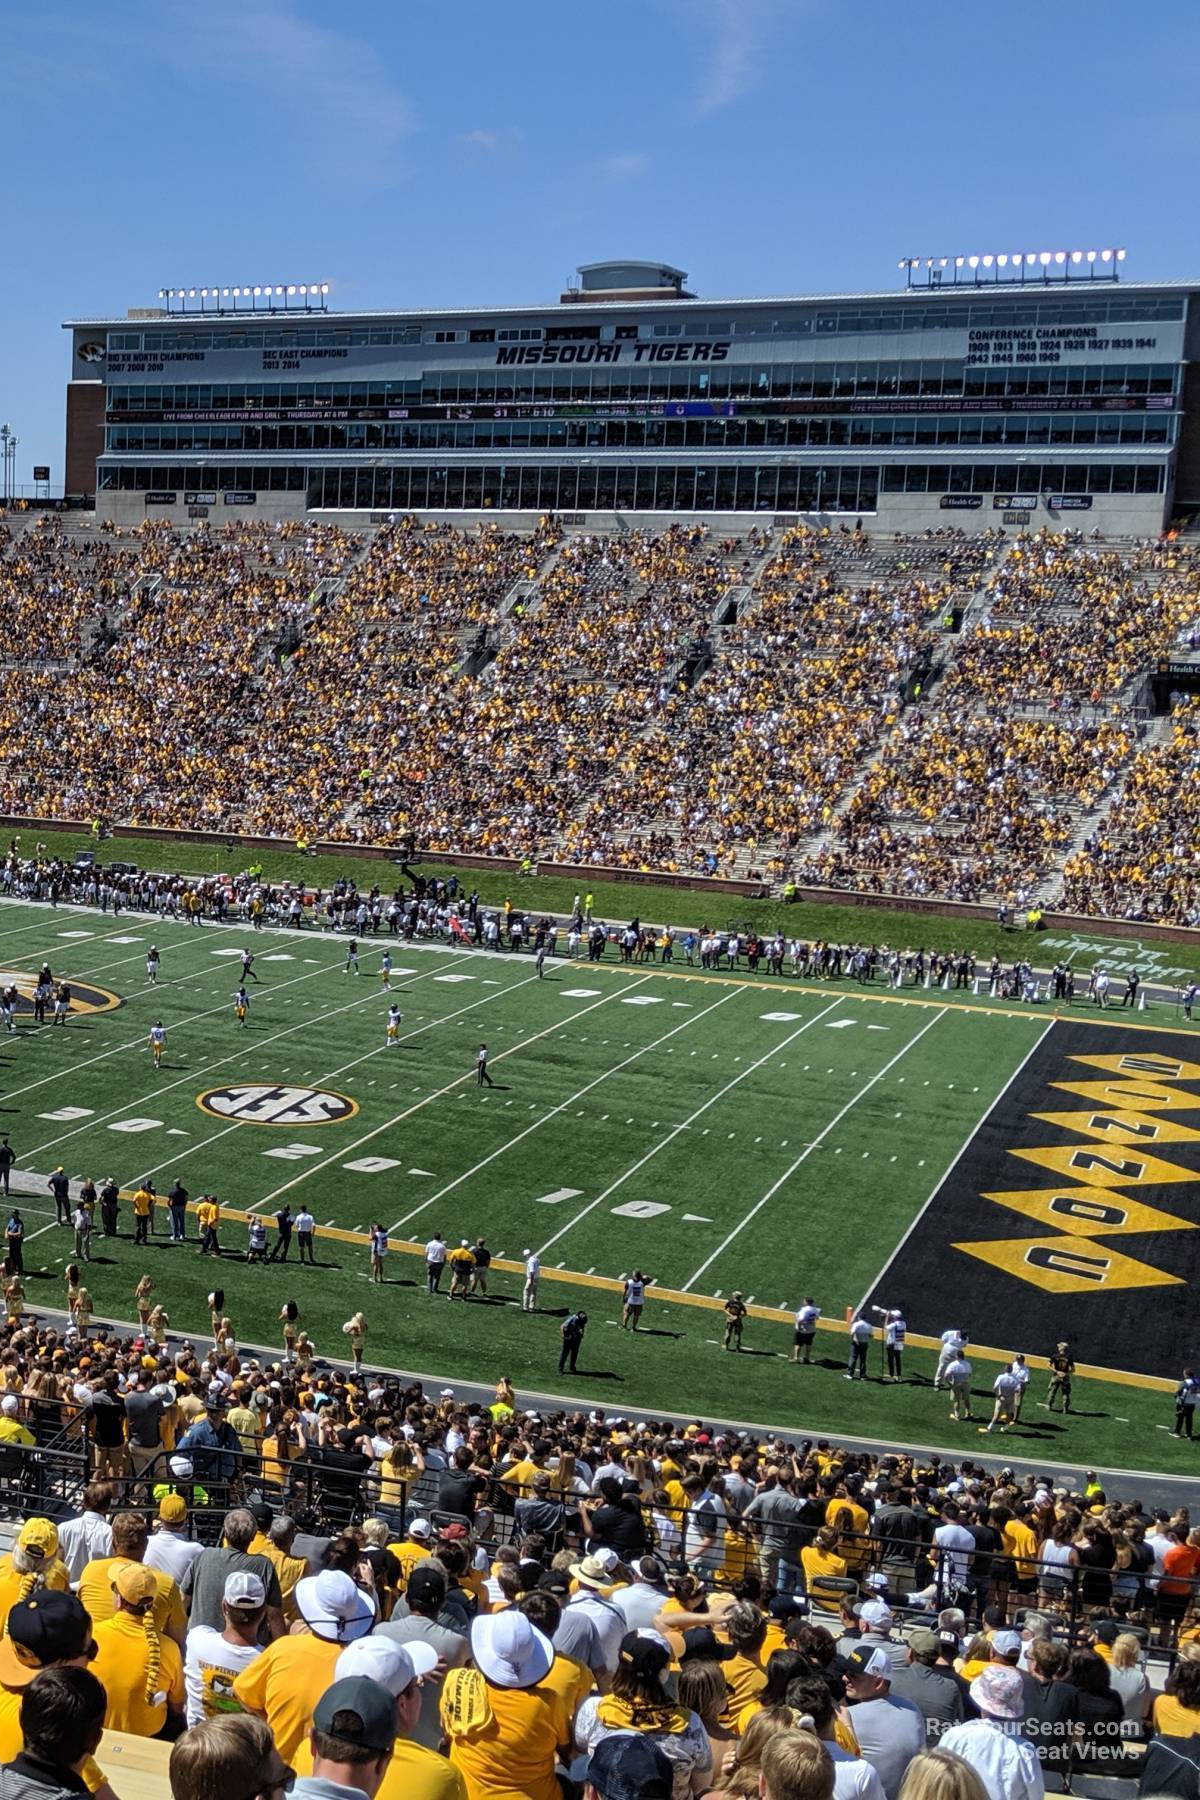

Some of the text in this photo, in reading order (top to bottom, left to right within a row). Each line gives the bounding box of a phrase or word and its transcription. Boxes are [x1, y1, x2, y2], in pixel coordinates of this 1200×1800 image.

[968, 327, 1098, 340] CONFERENCE CHAMPIONS
[968, 342, 991, 353] 1909
[1017, 341, 1038, 352] 1919
[1039, 340, 1062, 351] 1924
[1088, 339, 1111, 350] 1927
[1111, 338, 1134, 349] 1939
[1135, 338, 1158, 349] 1941
[133, 353, 158, 362] NORTH
[159, 352, 206, 361] CHAMPIONS
[262, 349, 349, 360] SEC EAST CHAMPIONS
[496, 342, 732, 365] MISSOURI TIGERS
[967, 352, 1061, 364] 1942 1945 1960 1969
[107, 363, 164, 372] 2007 2008 2010
[262, 360, 300, 370] 2013 2014
[163, 412, 176, 421] LIVE
[176, 412, 194, 420] FROM
[287, 411, 323, 419] THURSDAYS
[337, 410, 349, 418] PM
[494, 406, 508, 418] 31
[675, 405, 685, 416] 0
[948, 498, 968, 506] Health
[1094, 958, 1196, 977] RIGHT
[1023, 1055, 1183, 1284] MIZZOU
